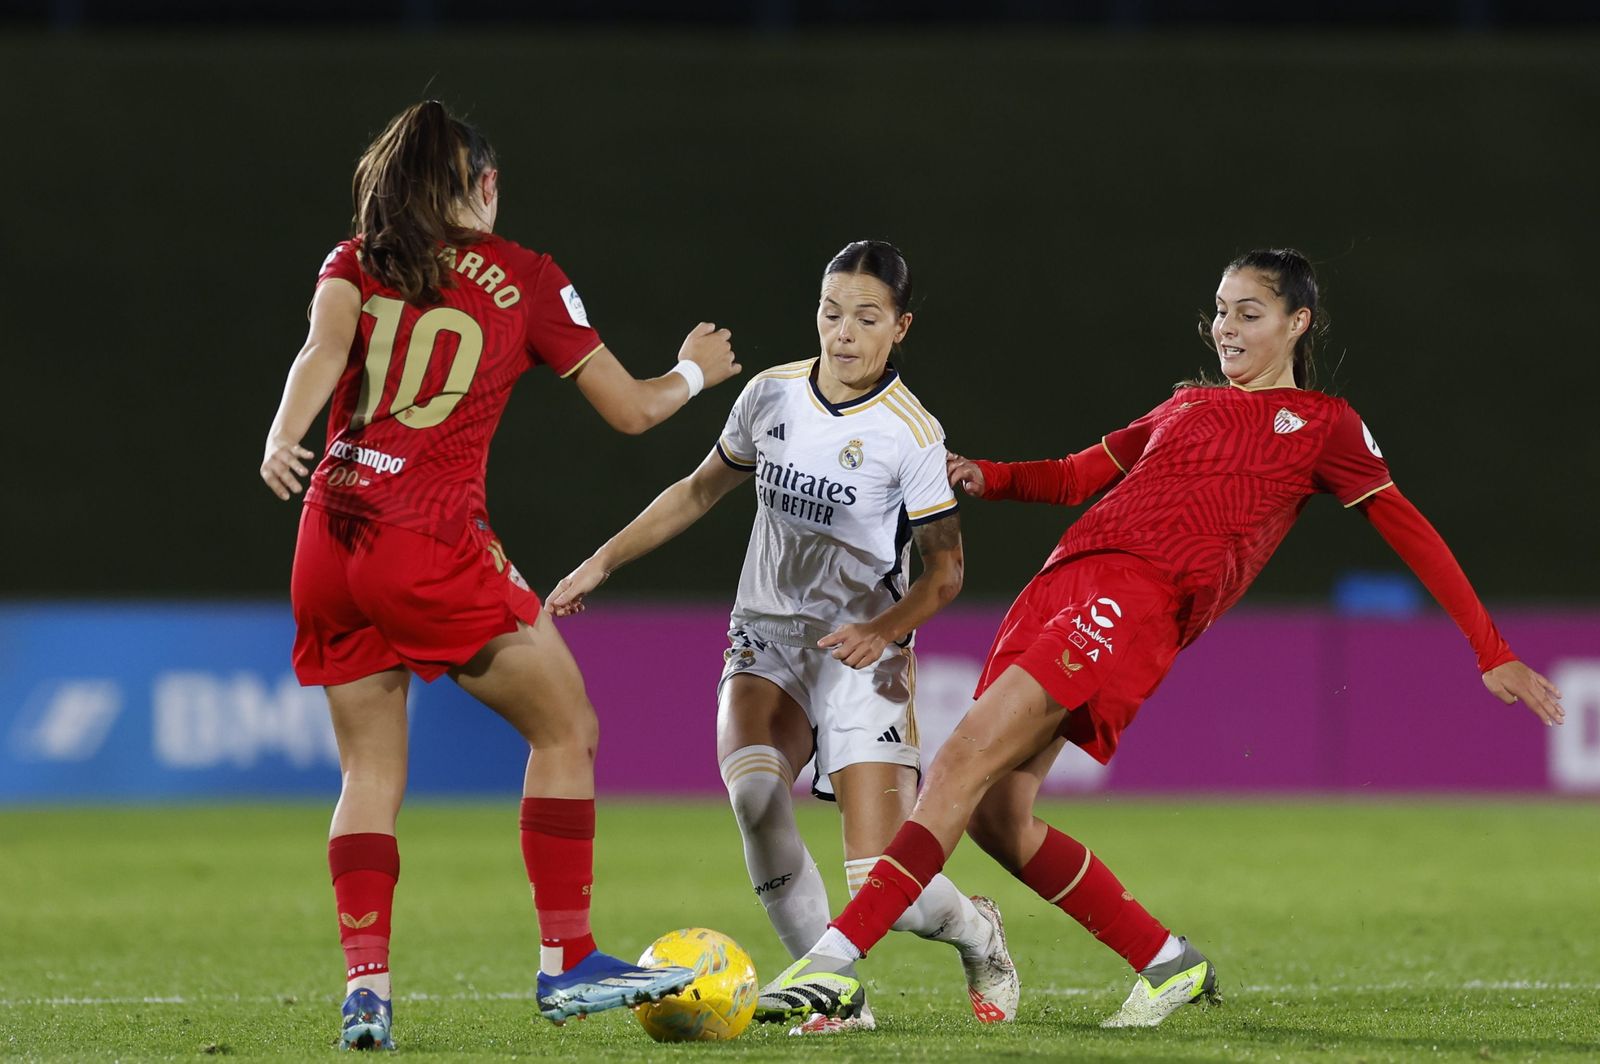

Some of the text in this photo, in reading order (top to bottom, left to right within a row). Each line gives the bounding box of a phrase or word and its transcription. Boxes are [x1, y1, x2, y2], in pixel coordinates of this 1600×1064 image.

[437, 246, 521, 309] ARRO
[350, 294, 484, 430] 10
[755, 451, 857, 506] Emirates
[758, 484, 834, 526] FLY BETTER
[1070, 614, 1113, 654] Andalucía
